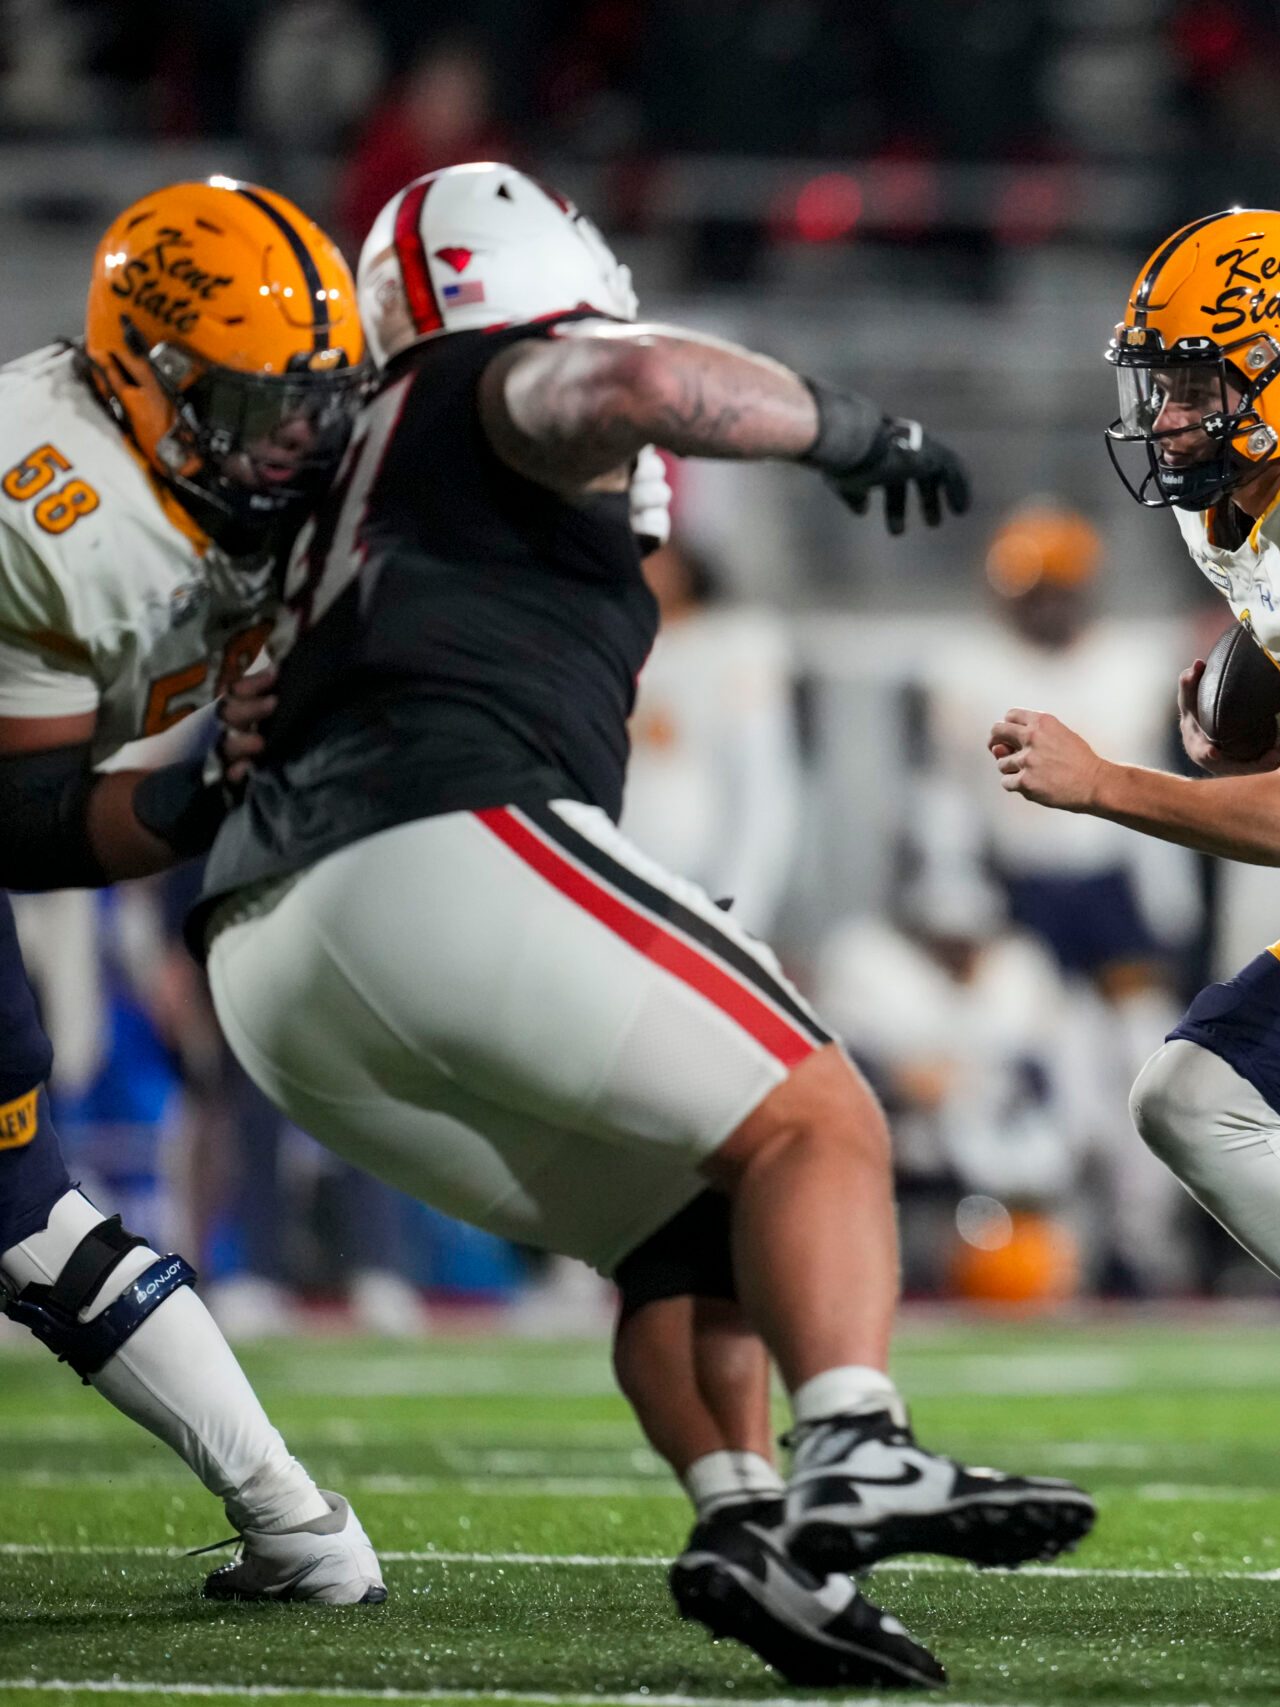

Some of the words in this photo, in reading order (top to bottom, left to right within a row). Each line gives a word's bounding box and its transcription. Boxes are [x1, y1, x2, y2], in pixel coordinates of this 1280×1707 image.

[110, 260, 200, 335] State
[140, 227, 234, 300] Kent
[1, 443, 101, 536] 58
